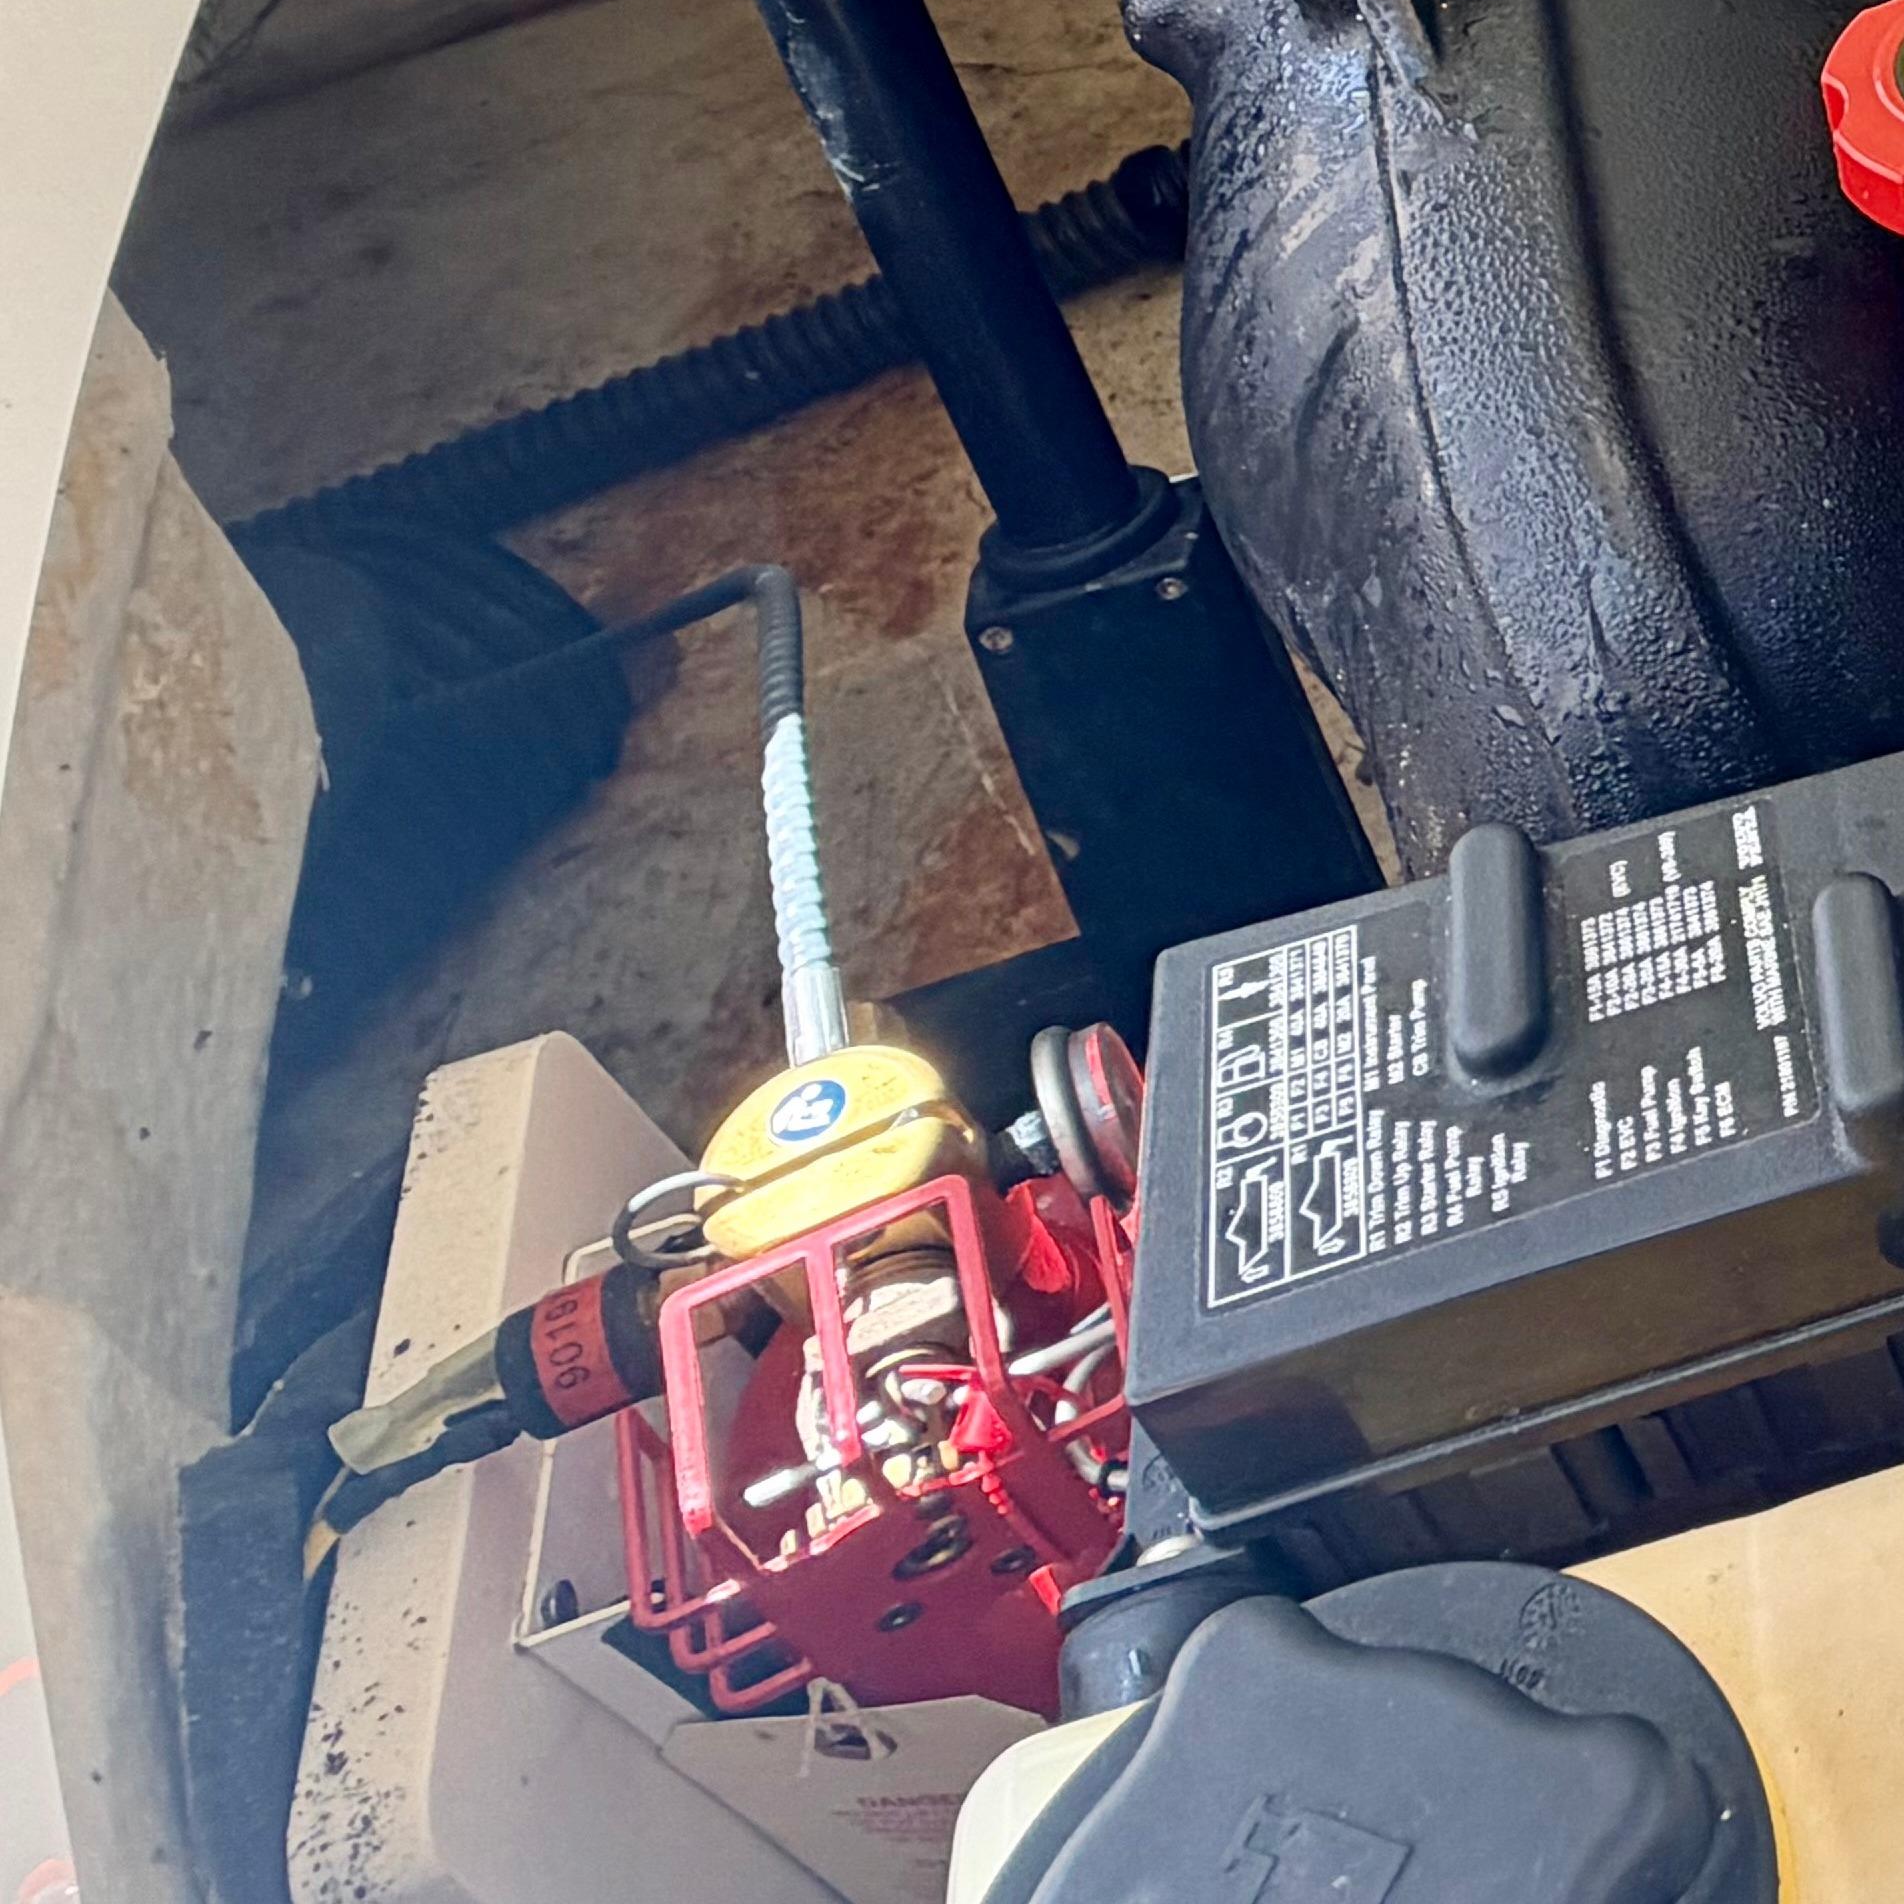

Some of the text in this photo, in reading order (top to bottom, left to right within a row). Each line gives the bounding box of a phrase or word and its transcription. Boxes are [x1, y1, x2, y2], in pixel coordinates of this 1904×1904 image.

[1609, 858, 1630, 899] (EVC)
[1361, 954, 1376, 994] Panel
[1738, 882, 1773, 1030] VOLVO PARTS COMPLY
[1409, 975, 1430, 1020] Pump
[1767, 986, 1787, 1024] WITH
[1217, 1028, 1233, 1050] R4
[1362, 992, 1379, 1068] Instrument
[1386, 1011, 1402, 1060] Starter
[1411, 1018, 1427, 1052] Trim
[1637, 1062, 1660, 1108] Pump
[1684, 1045, 1706, 1095] Switch
[1216, 1096, 1233, 1120] R3
[1587, 1079, 1612, 1158] Diagnostic
[1663, 1076, 1686, 1133] Ignition
[1713, 1079, 1734, 1117] ECM
[1616, 1114, 1635, 1149] EVC
[1641, 1106, 1660, 1141] Fuel
[1291, 1142, 1307, 1165] R1
[1417, 1116, 1437, 1236] R3 Starter Relay
[1443, 1123, 1464, 1228] R4 Fuel Pump
[1464, 1151, 1486, 1198] Relay
[1488, 1131, 1510, 1213] R5 Ignition
[1508, 1137, 1530, 1184] Relay
[1216, 1164, 1232, 1190] R2
[1364, 1105, 1386, 1253] R1 Trim Down Relay
[1391, 1116, 1413, 1245] R2 Trim Up Relay
